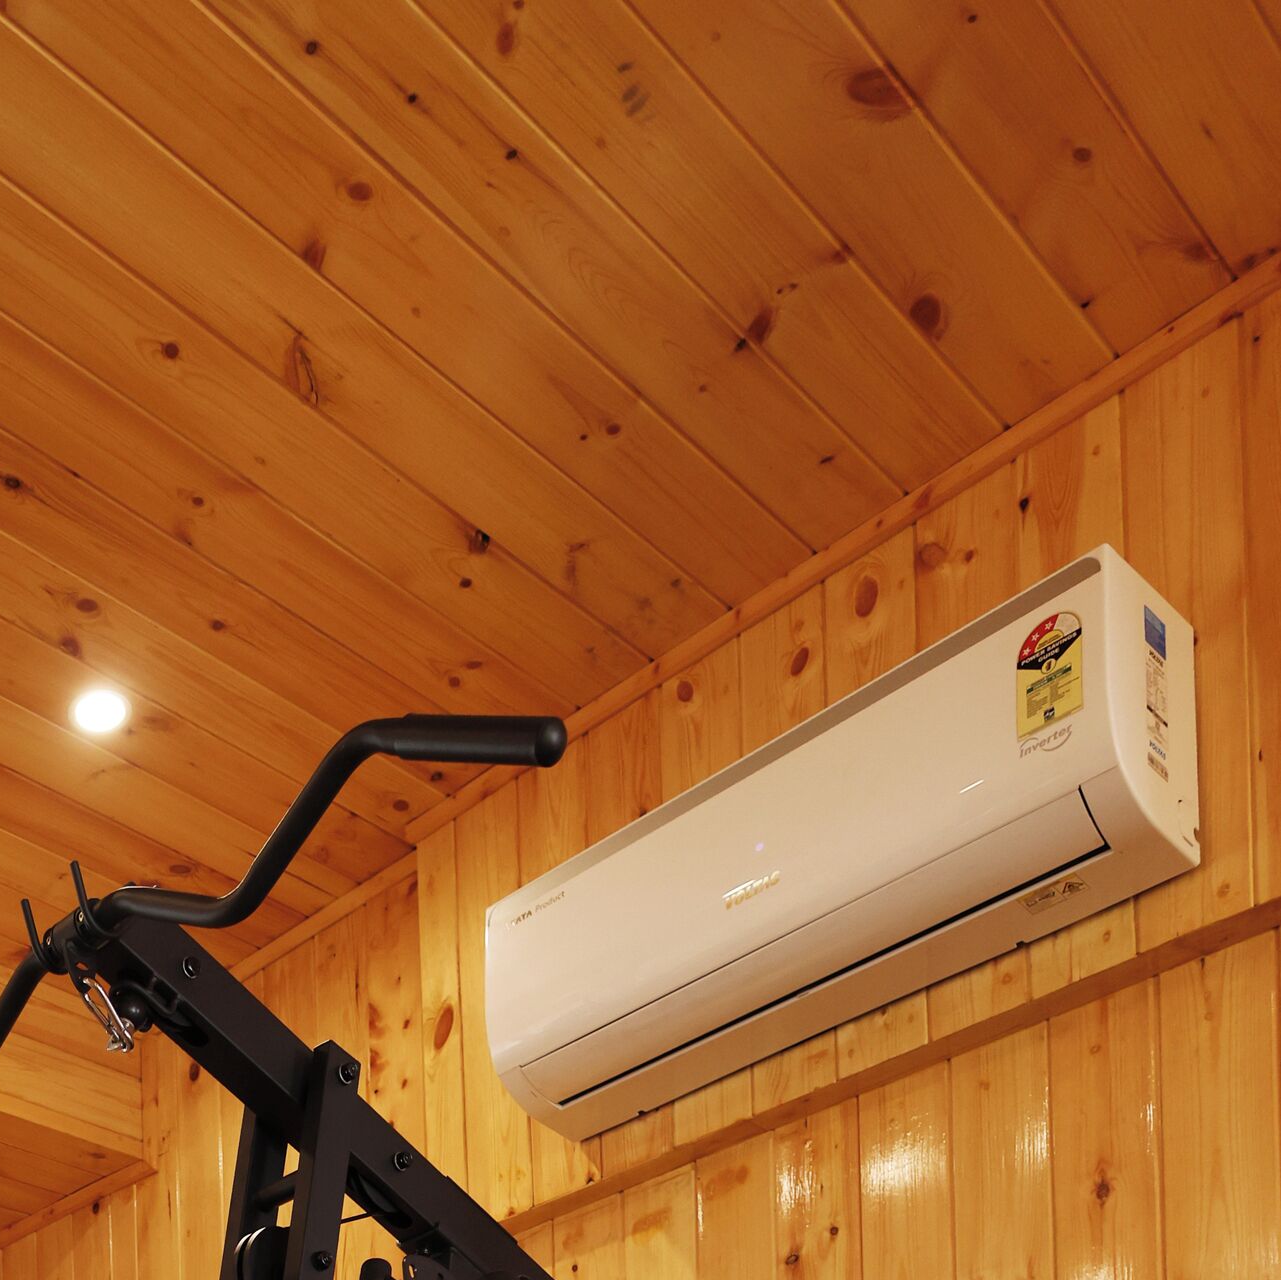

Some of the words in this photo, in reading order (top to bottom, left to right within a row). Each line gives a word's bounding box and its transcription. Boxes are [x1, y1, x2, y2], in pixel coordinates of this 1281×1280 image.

[1021, 650, 1046, 667] POWER
[1047, 632, 1078, 652] SAVINGS
[1038, 647, 1060, 663] GUIDE
[1020, 724, 1074, 759] Inverter
